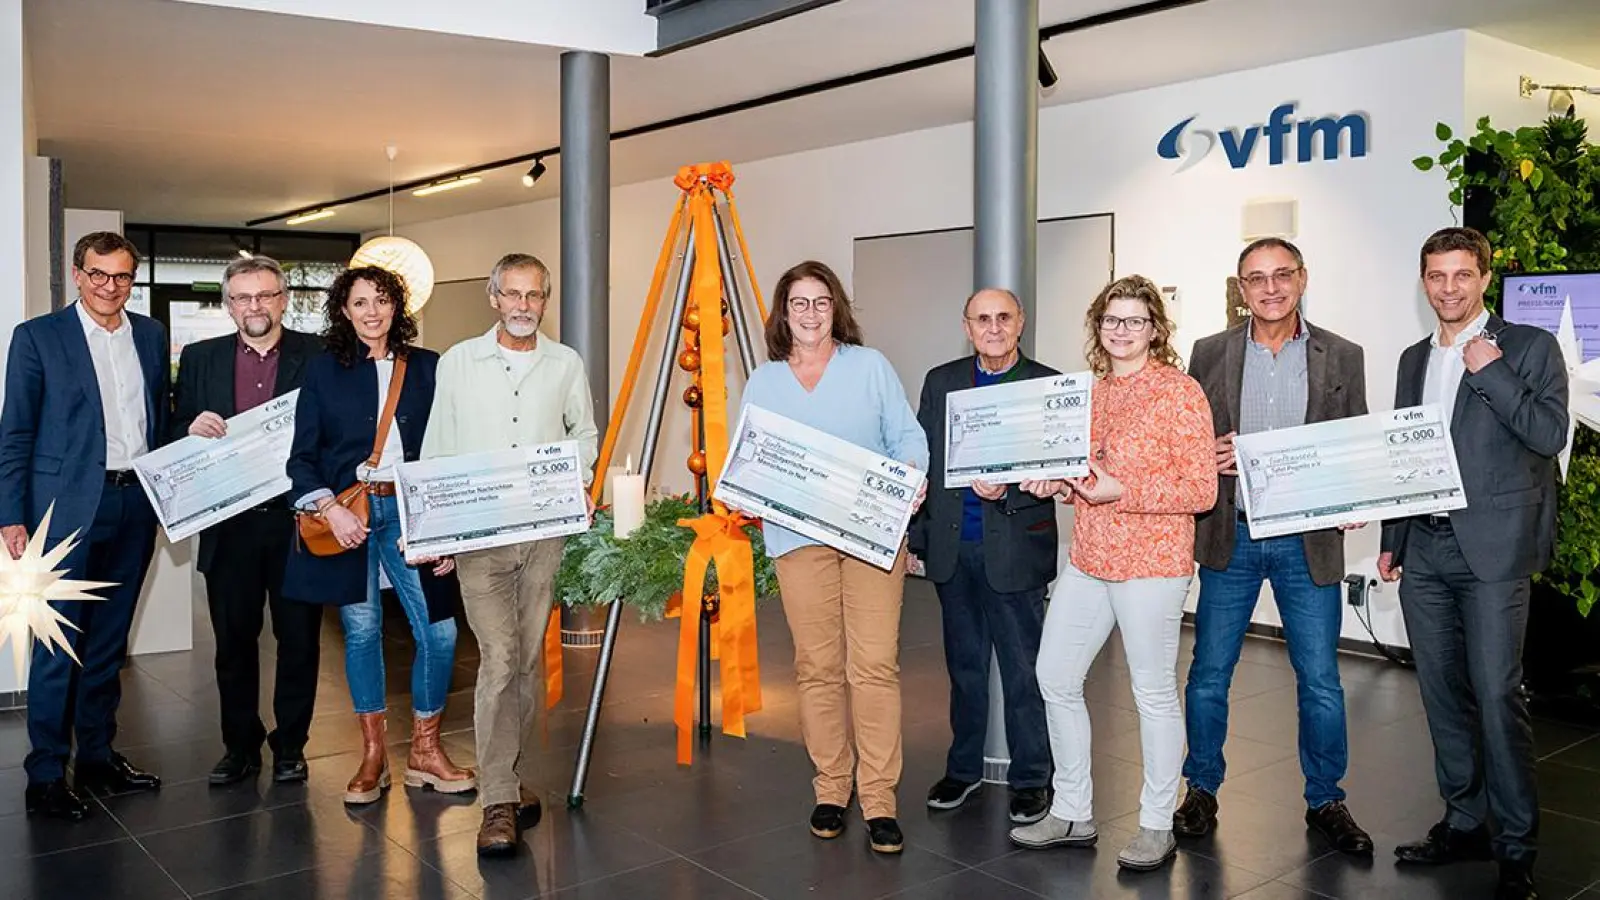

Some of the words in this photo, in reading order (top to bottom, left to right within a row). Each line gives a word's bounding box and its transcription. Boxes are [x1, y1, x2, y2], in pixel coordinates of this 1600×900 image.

[1219, 103, 1367, 169] vfm
[1530, 282, 1557, 295] vfm
[1403, 411, 1424, 421] vfm
[1402, 428, 1435, 444] 5.000
[542, 461, 569, 475] 5.000
[889, 465, 908, 478] vfm
[877, 480, 905, 499] 5.000
